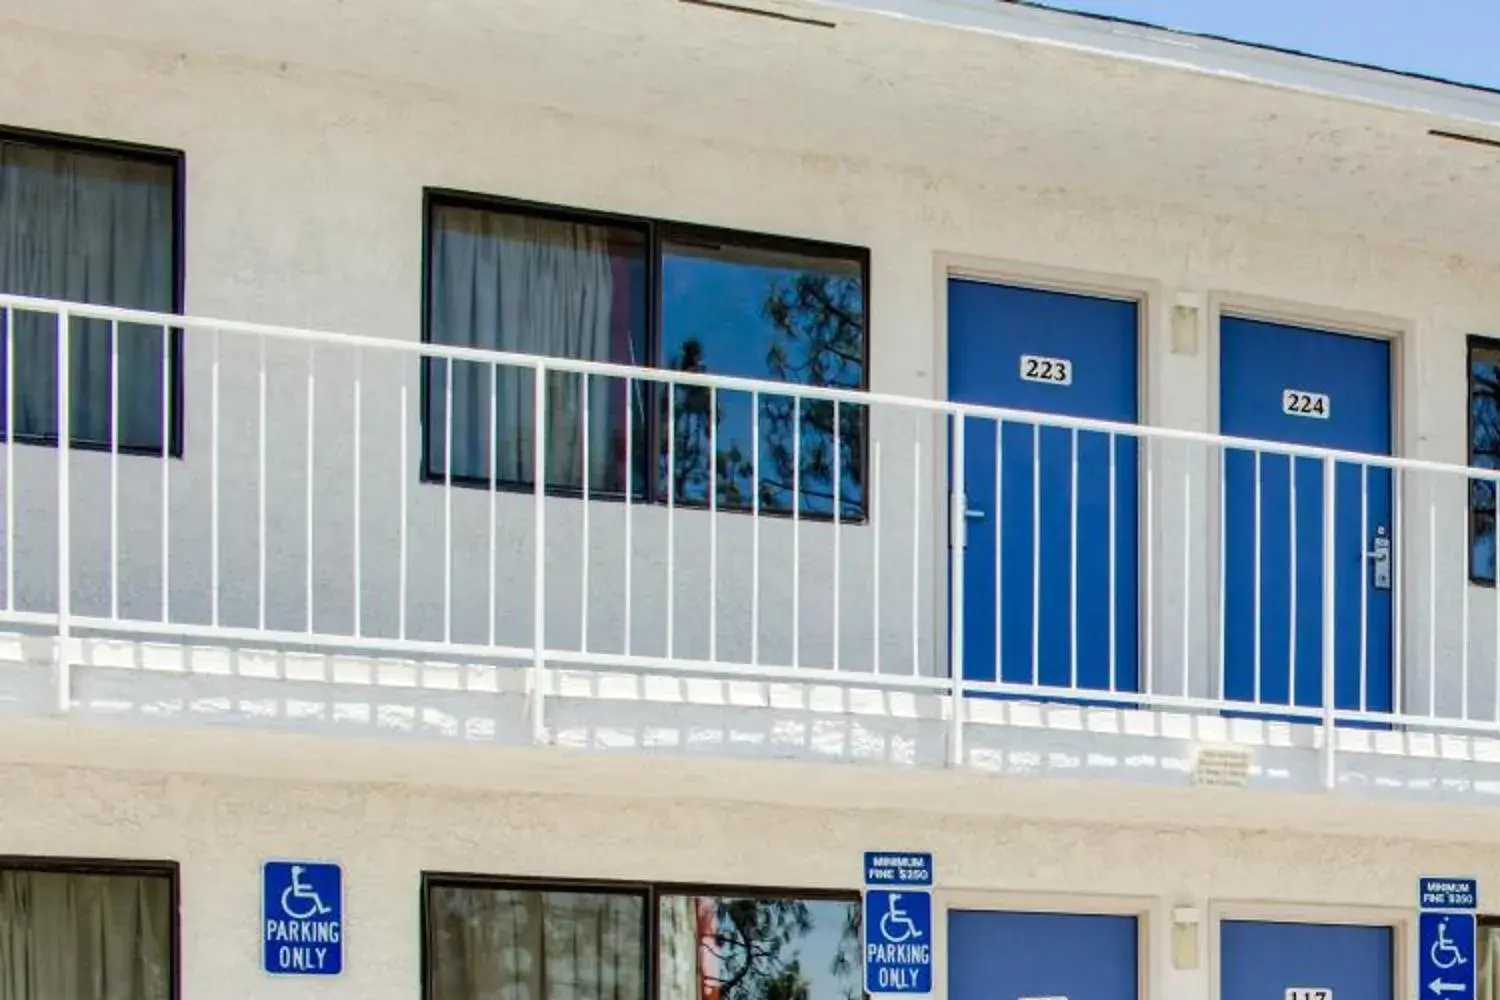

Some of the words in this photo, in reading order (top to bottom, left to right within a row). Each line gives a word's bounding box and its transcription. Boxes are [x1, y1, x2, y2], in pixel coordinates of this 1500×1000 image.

[1025, 358, 1067, 382] 223
[1287, 392, 1325, 416] 224
[873, 856, 925, 867] MINIMUM
[869, 868, 895, 879] FINE
[267, 919, 339, 943] PARKING
[279, 945, 327, 971] ONLY
[867, 943, 929, 965] PARKING
[879, 966, 920, 989] ONLY
